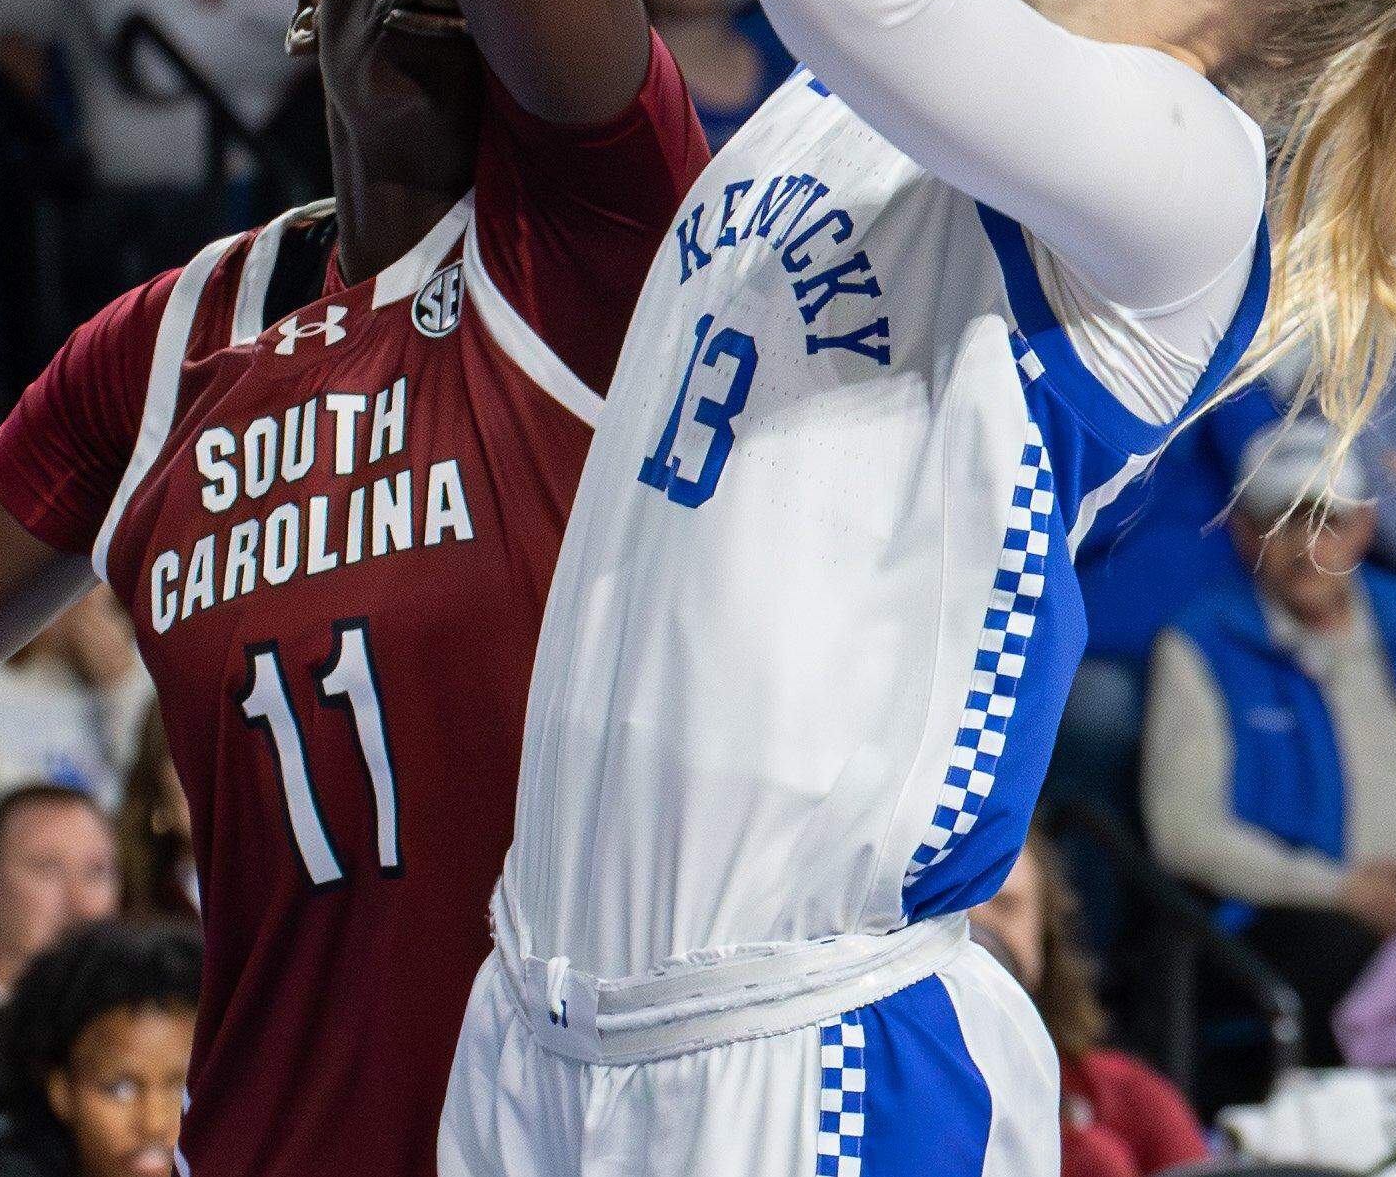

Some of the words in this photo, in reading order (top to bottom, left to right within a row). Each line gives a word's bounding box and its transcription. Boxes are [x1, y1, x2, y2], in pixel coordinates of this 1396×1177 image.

[196, 379, 407, 514] SOUTH
[638, 313, 759, 508] 13
[150, 459, 474, 635] CAROLINA
[239, 616, 404, 890] 11
